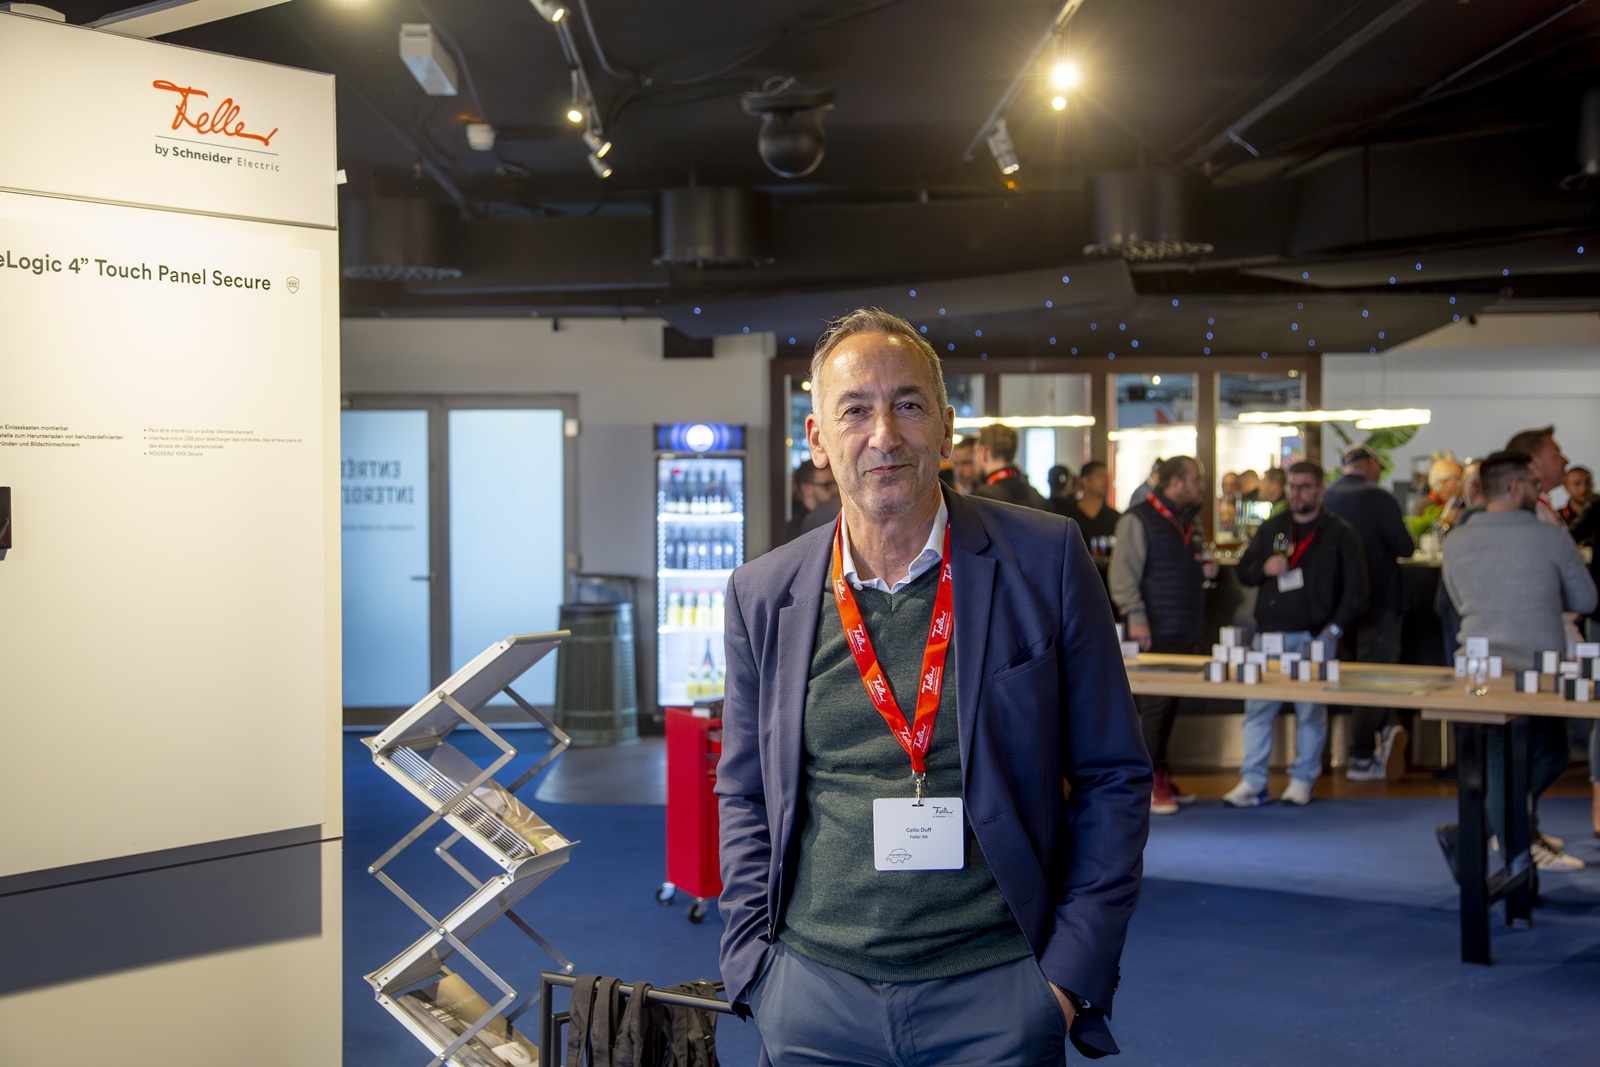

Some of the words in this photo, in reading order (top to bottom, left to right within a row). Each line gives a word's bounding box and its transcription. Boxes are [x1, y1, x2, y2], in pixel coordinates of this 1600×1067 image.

[152, 79, 279, 147] Feller
[155, 143, 169, 157] by
[172, 146, 233, 165] Schneider
[237, 157, 280, 172] Electric
[94, 259, 152, 281] Touch
[158, 265, 207, 286] Panel
[212, 270, 271, 291] Secure
